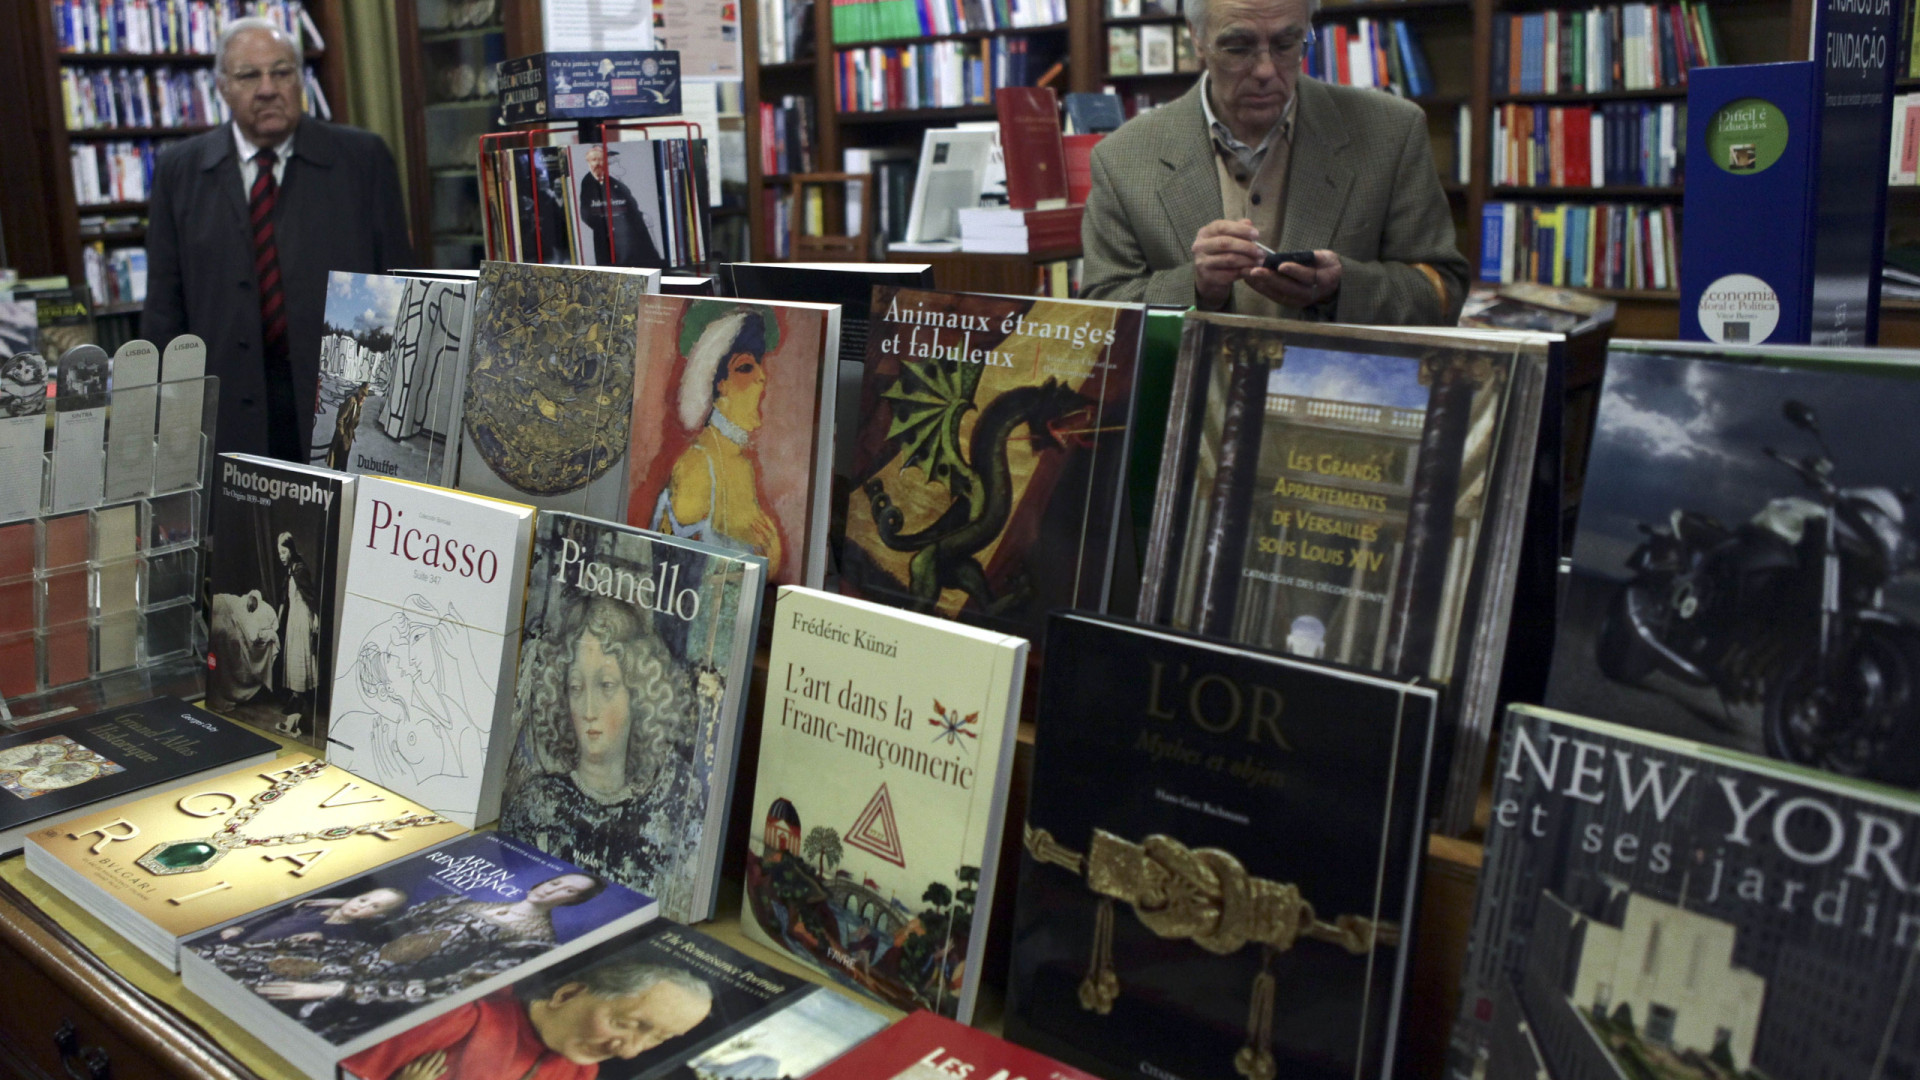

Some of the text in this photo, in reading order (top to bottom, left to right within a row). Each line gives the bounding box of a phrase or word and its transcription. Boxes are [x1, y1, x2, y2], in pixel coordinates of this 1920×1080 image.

[1826, 26, 1887, 79] FUNDAÇÃO
[1706, 287, 1776, 301] conomia
[174, 342, 199, 351] LISBOA
[881, 326, 1015, 368] et fabuleux
[883, 296, 1116, 350] Animaux étranges
[125, 348, 150, 357] LISBOA
[223, 462, 334, 511] Photography
[357, 454, 399, 476] Dubuffet
[366, 499, 498, 584] Picasso
[1348, 549, 1384, 572] XIV
[413, 569, 442, 585] Suite 347
[556, 537, 700, 621] Pisanello
[792, 612, 899, 658] Frédéric Künzi
[785, 662, 913, 731] L'art dans la
[1147, 661, 1292, 751] L'OR
[781, 697, 973, 790] Franc-maçonnerie
[1506, 726, 1920, 893] NEW YOR
[458, 855, 515, 884] ART IN
[1496, 798, 1920, 948] et ses jardin
